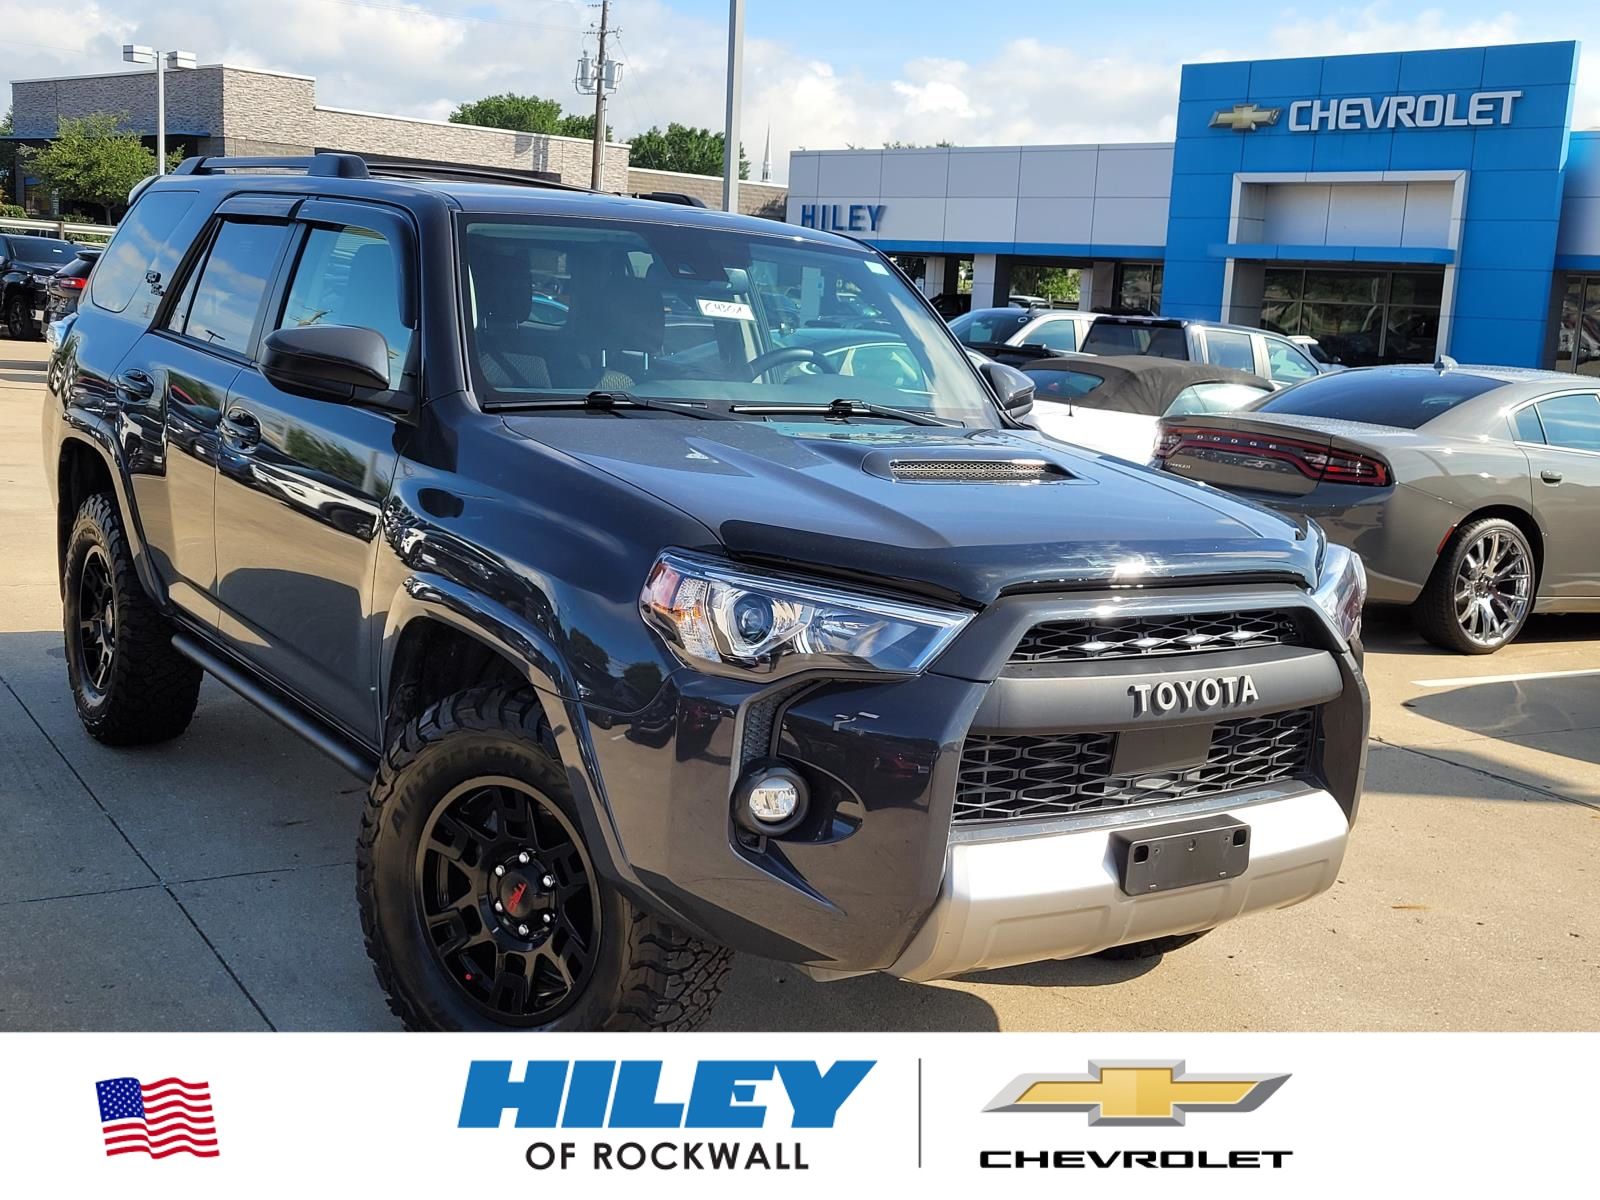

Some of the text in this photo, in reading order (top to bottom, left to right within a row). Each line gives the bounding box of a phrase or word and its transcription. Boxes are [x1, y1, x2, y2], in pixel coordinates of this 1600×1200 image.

[1288, 90, 1522, 132] CHEVROLET
[801, 204, 886, 231] HILEY
[1197, 434, 1277, 449] DODGE
[1129, 675, 1259, 715] TOYOTA
